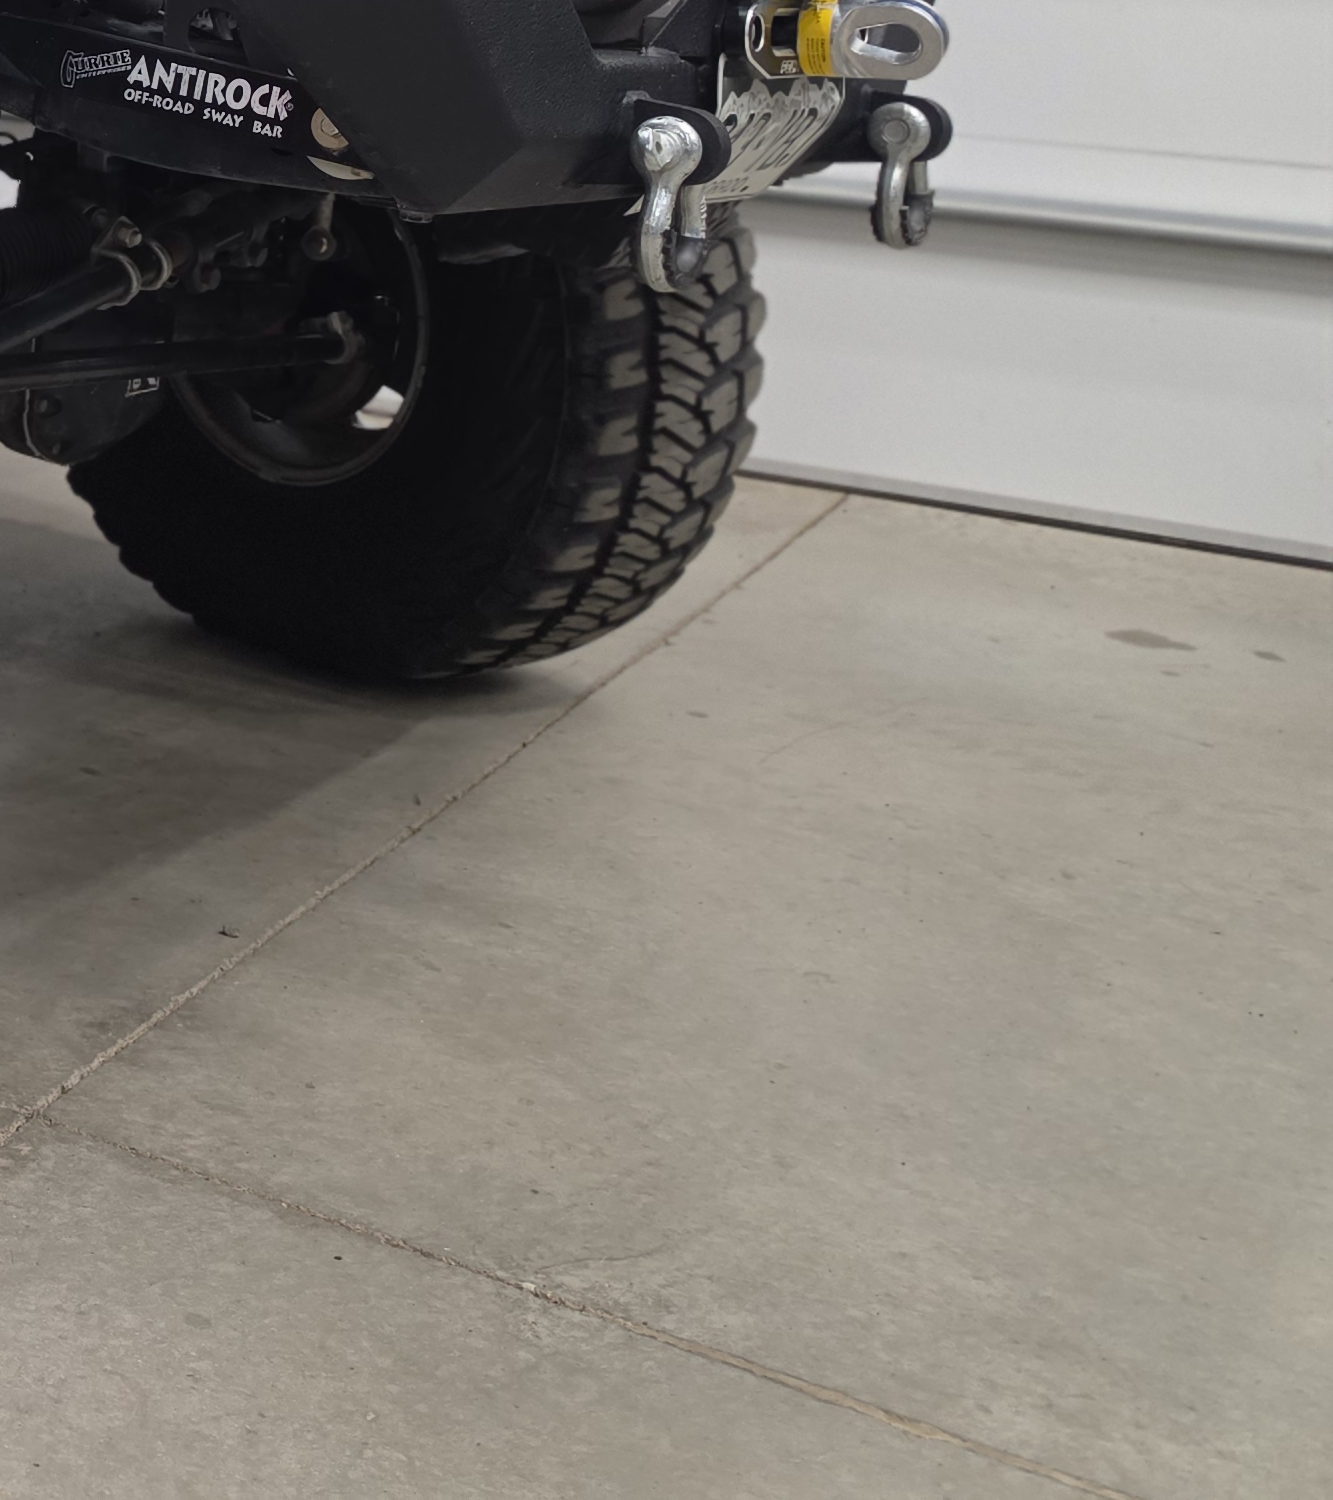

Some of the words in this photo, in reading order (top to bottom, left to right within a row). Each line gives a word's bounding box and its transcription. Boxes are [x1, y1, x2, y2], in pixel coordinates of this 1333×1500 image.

[60, 49, 132, 88] CURRIE
[123, 88, 195, 115] OFF-ROAD
[202, 107, 244, 128] SWAY
[252, 120, 283, 139] BAR
